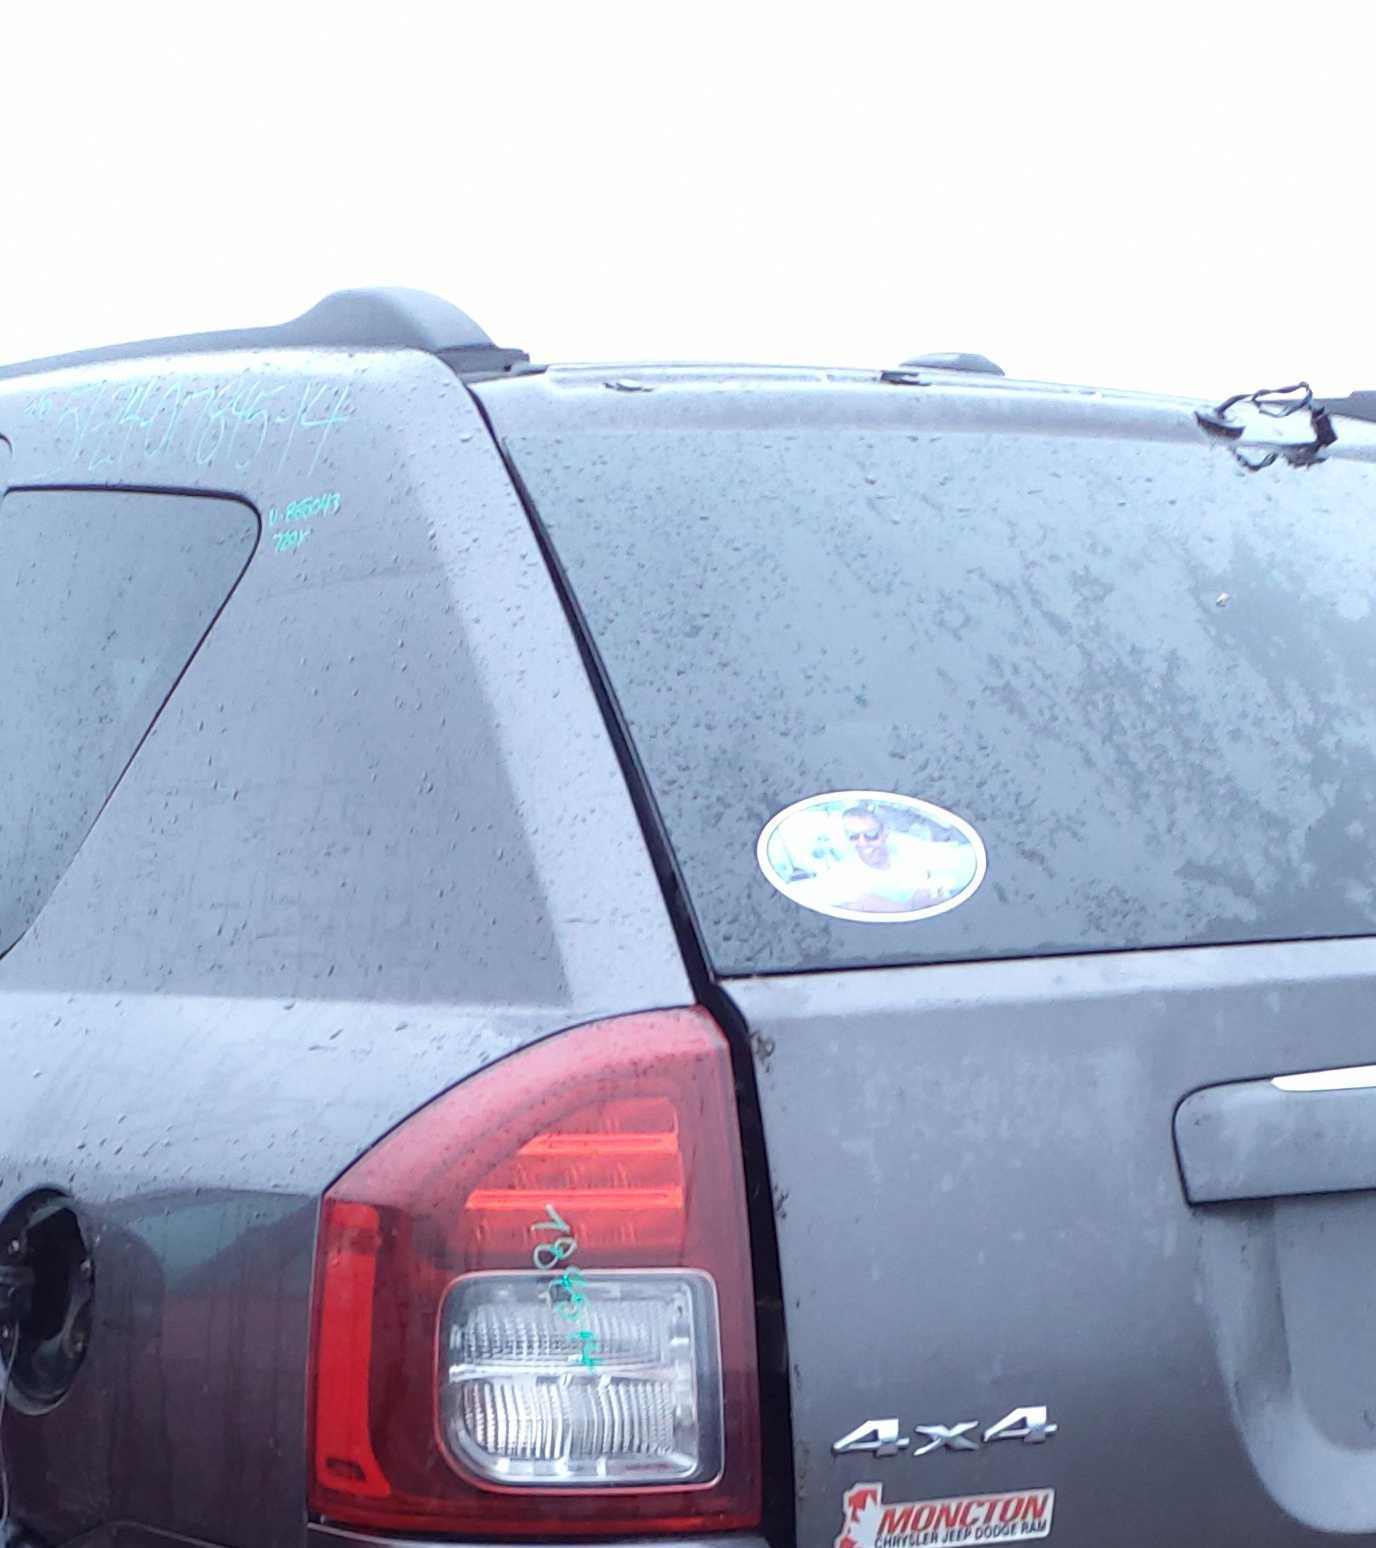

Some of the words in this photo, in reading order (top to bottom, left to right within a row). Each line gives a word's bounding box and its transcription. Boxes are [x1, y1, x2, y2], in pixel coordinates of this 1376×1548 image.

[832, 1405, 1058, 1458] 4x4
[876, 1493, 1049, 1536] MONCTON
[941, 1526, 973, 1544] JEEP
[975, 1522, 1019, 1539] DODGE
[1021, 1518, 1048, 1535] RAM
